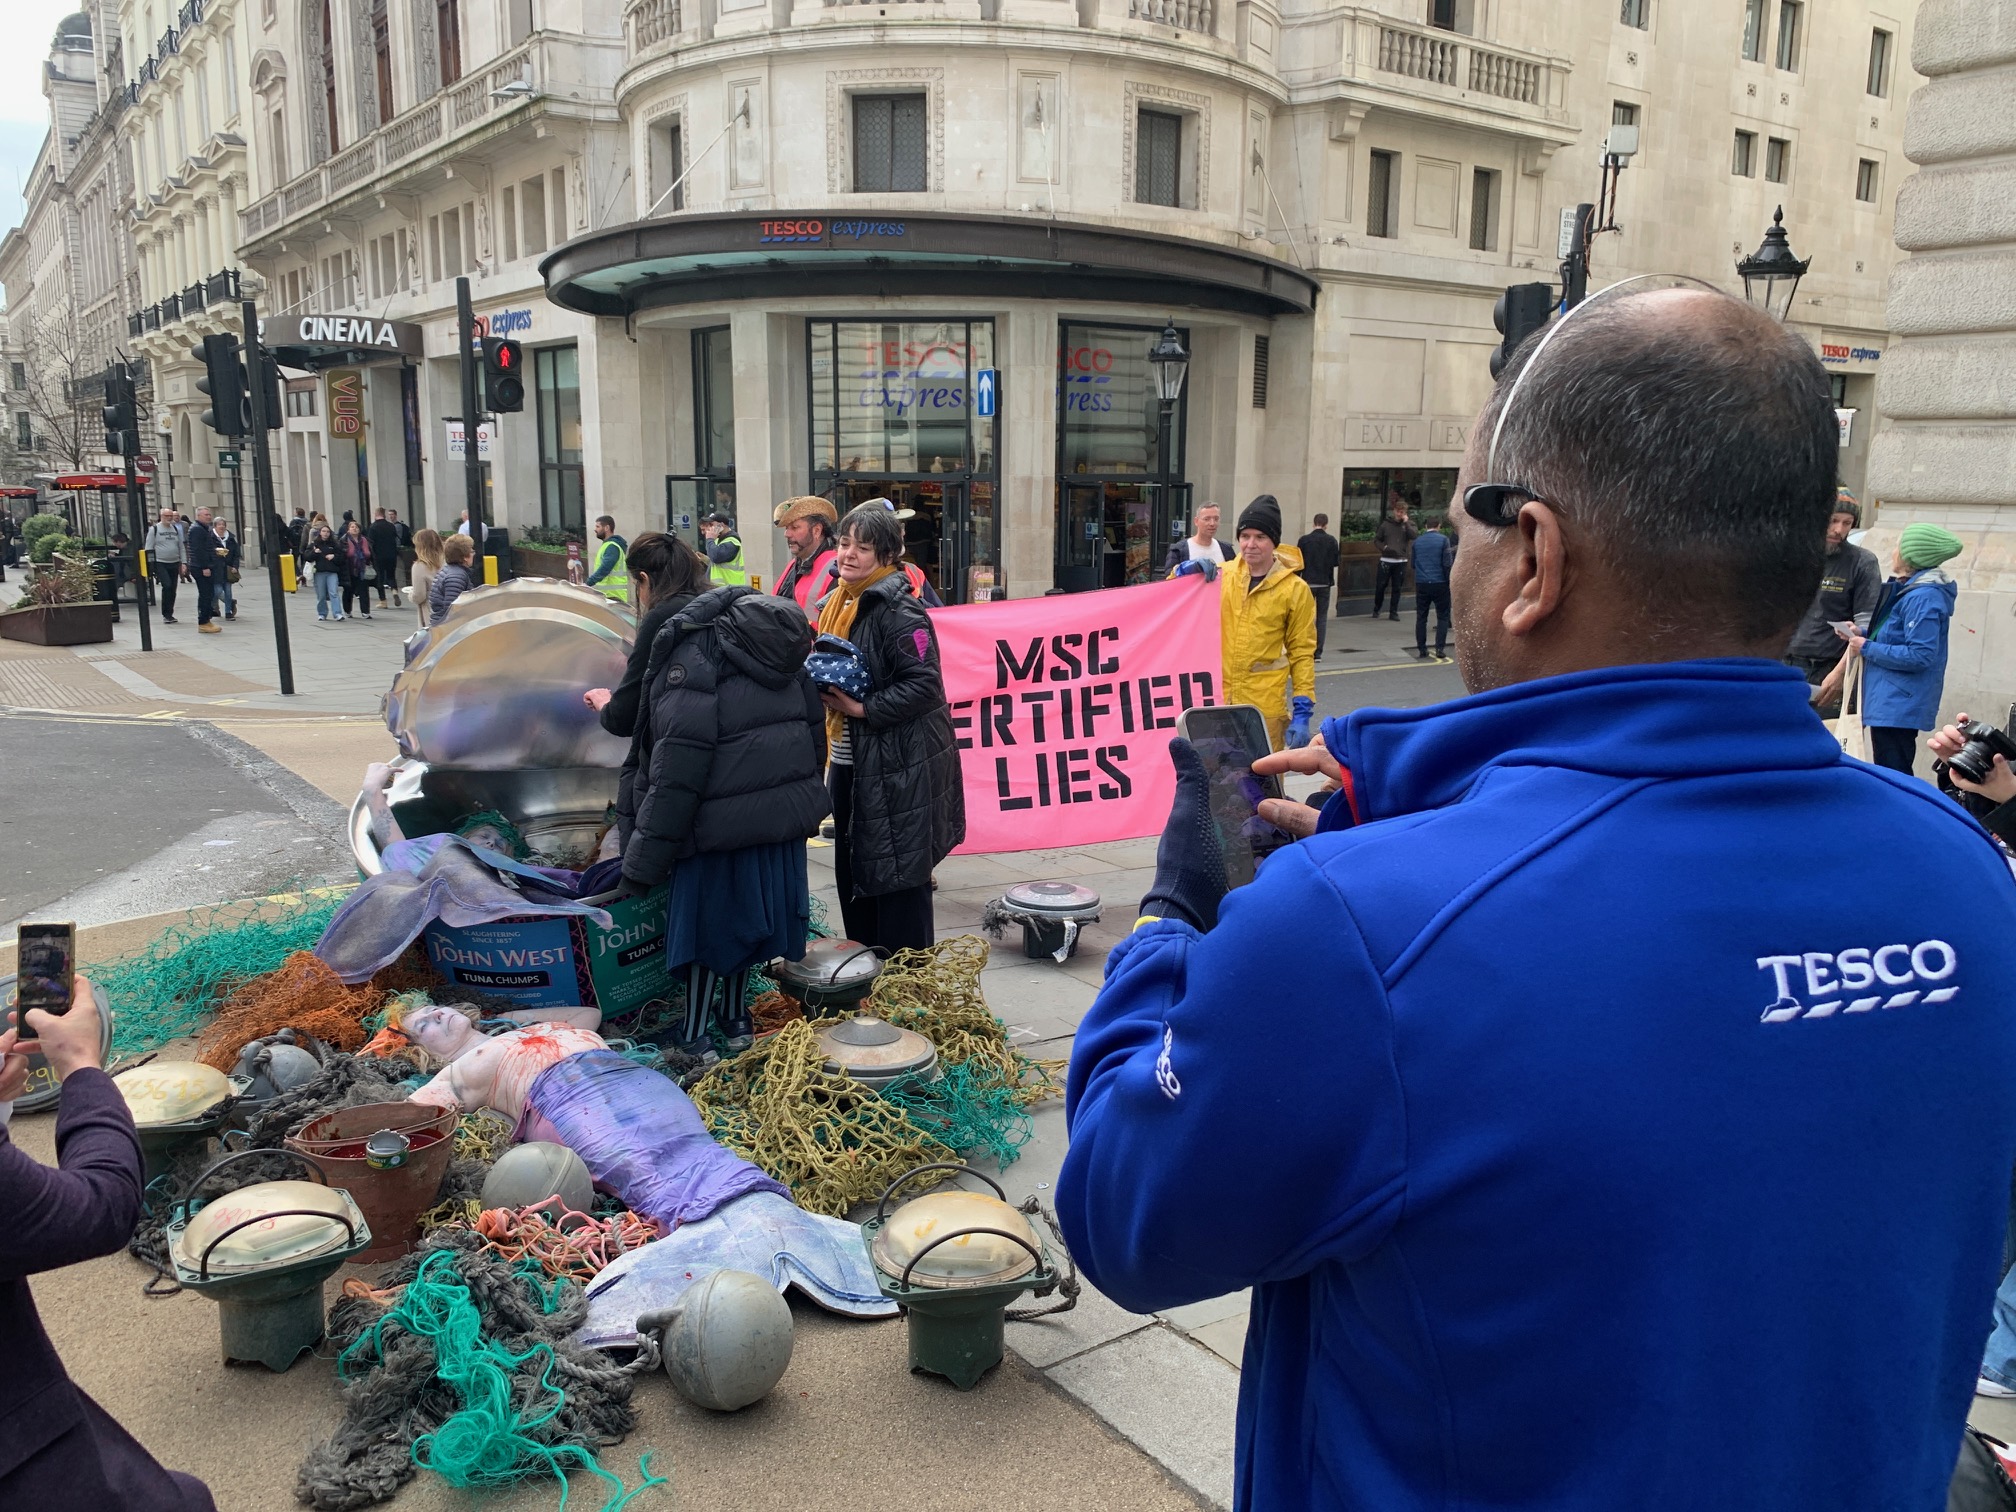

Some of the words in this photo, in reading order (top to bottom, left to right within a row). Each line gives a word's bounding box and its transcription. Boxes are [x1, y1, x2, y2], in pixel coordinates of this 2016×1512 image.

[760, 220, 823, 236] TESCO
[832, 220, 905, 240] express
[1563, 220, 1576, 229] STRE
[300, 316, 399, 348] CINEMA
[492, 308, 532, 340] express
[859, 341, 978, 369] TESCO
[1056, 346, 1113, 373] SCO
[1821, 344, 1850, 358] TESCO
[1850, 347, 1881, 362] express
[859, 384, 978, 417] express
[450, 431, 488, 439] TEO
[1361, 424, 1408, 444] EXIT
[1445, 426, 1468, 444] EX
[752, 576, 760, 589] H
[974, 591, 992, 601] SALA
[996, 627, 1119, 689] MSC
[949, 672, 1215, 750] ERTIFIED
[996, 745, 1132, 812] LIES
[462, 929, 521, 938] SLAUGHTERING
[597, 917, 656, 957] JOHN
[434, 941, 494, 967] JOHN
[496, 946, 568, 968] WEST
[627, 943, 656, 960] TUNA
[463, 973, 494, 984] TUNA
[495, 975, 540, 984] CHUMPS
[1756, 939, 1956, 998] TESCO
